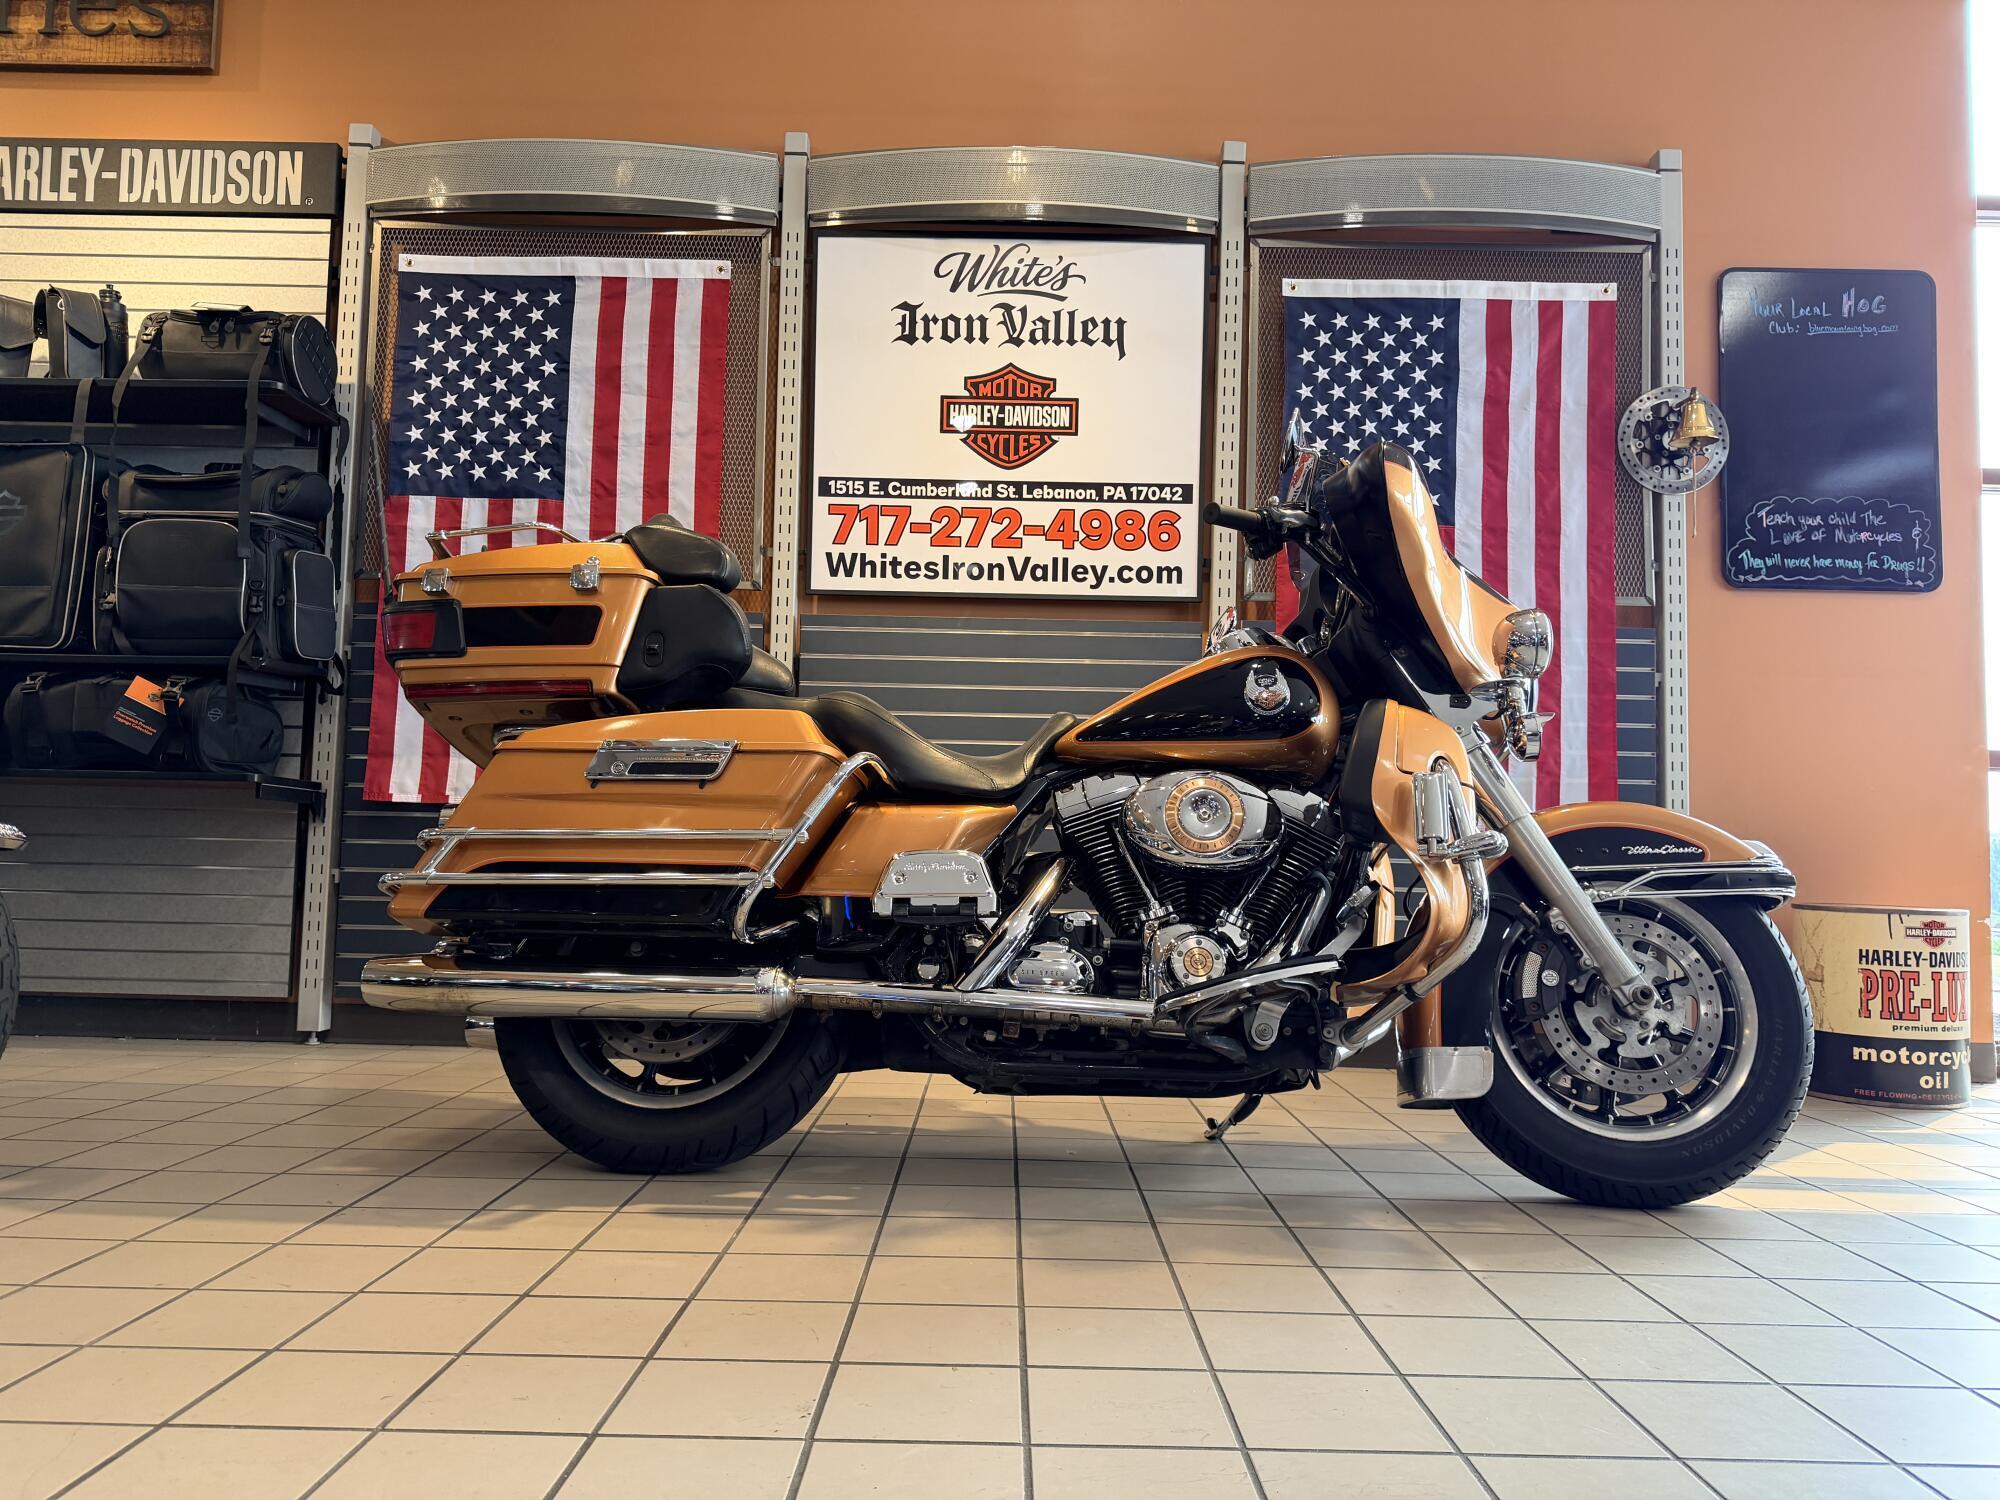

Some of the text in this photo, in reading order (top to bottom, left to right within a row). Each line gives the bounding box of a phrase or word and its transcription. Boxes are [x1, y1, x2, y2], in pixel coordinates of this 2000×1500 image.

[933, 242, 1087, 300] White's
[890, 300, 1128, 361] Iron Valley
[978, 373, 1043, 398] MOTOR
[949, 404, 1070, 428] HARLEY-DAVIDSON
[976, 433, 1041, 462] CYCLES
[828, 480, 1183, 502] 1515 E. Cumberland St. Lebanon, PA 17042
[827, 503, 1181, 552] 717-272-4986
[825, 552, 1183, 590] WhitesIronValley.com
[1892, 1024, 1938, 1033] premium
[1854, 1088, 1876, 1097] FREE
[1919, 1071, 1950, 1089] oil
